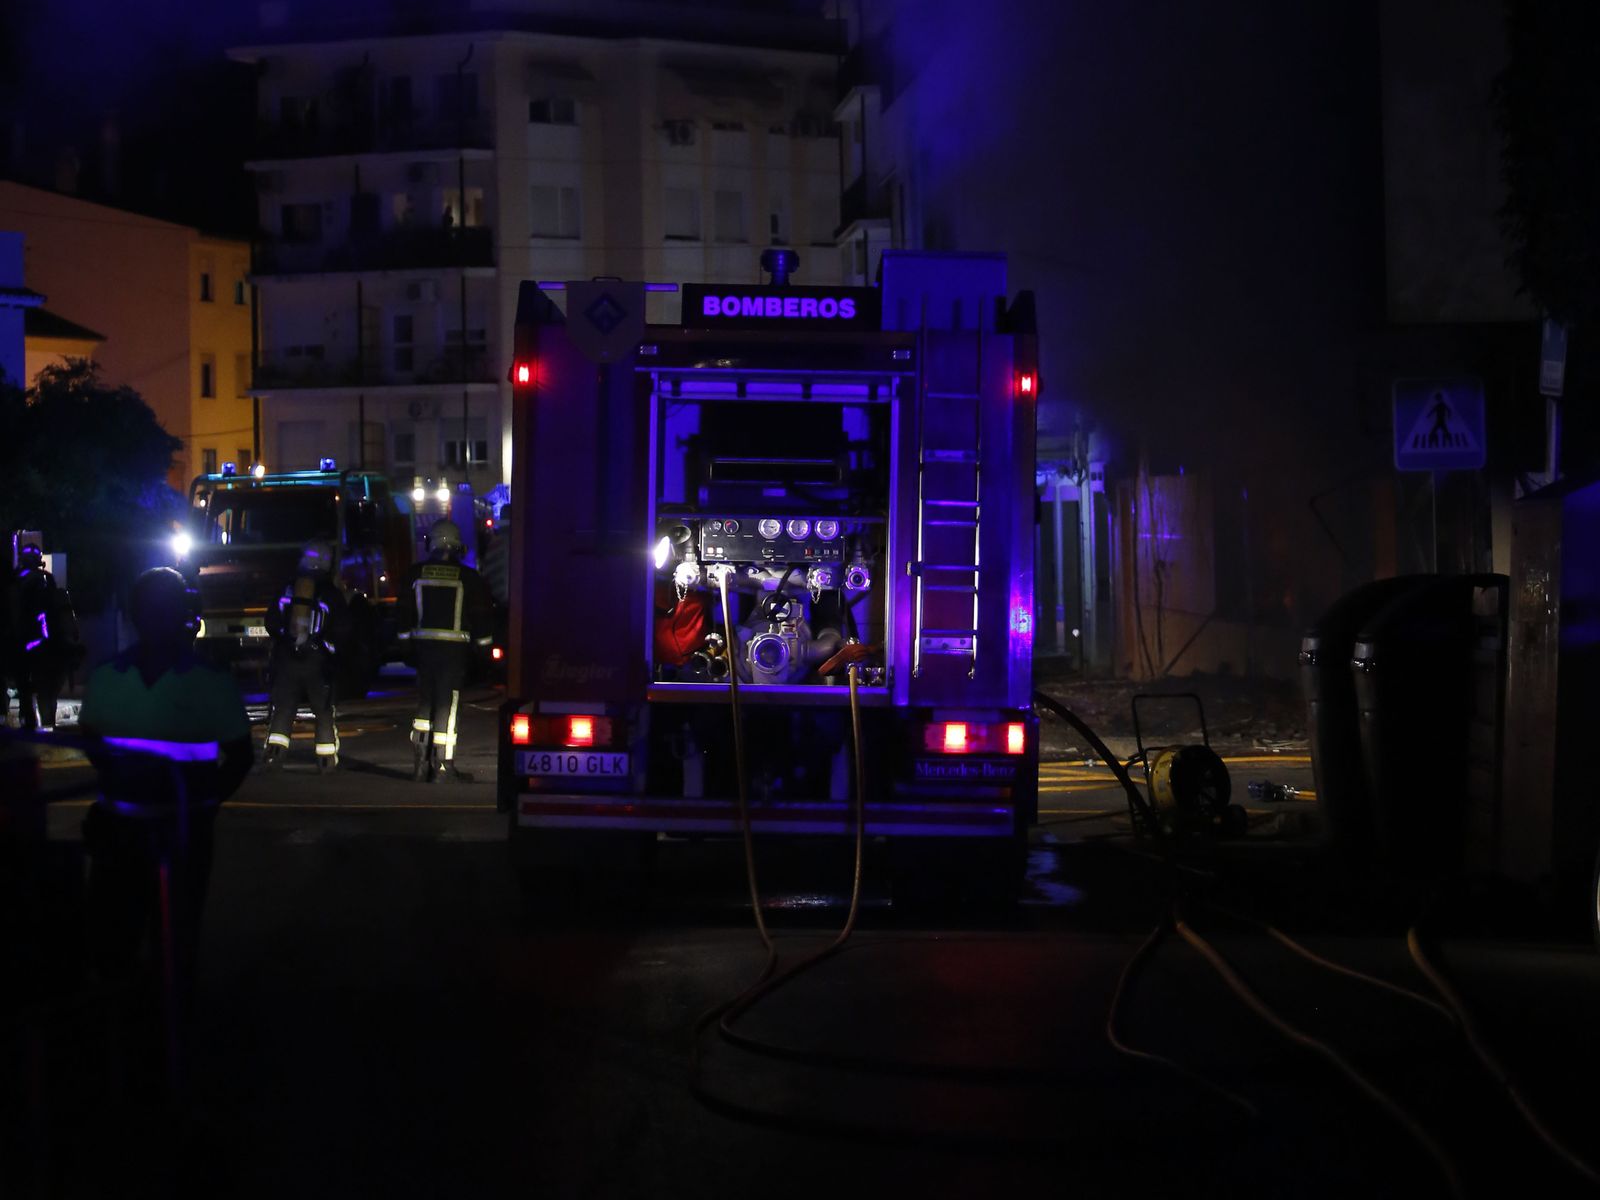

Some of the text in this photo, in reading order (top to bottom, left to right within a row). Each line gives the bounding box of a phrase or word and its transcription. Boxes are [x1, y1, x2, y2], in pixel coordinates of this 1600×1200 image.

[703, 294, 856, 319] BOMBEROS
[527, 754, 624, 774] 4810 GLK
